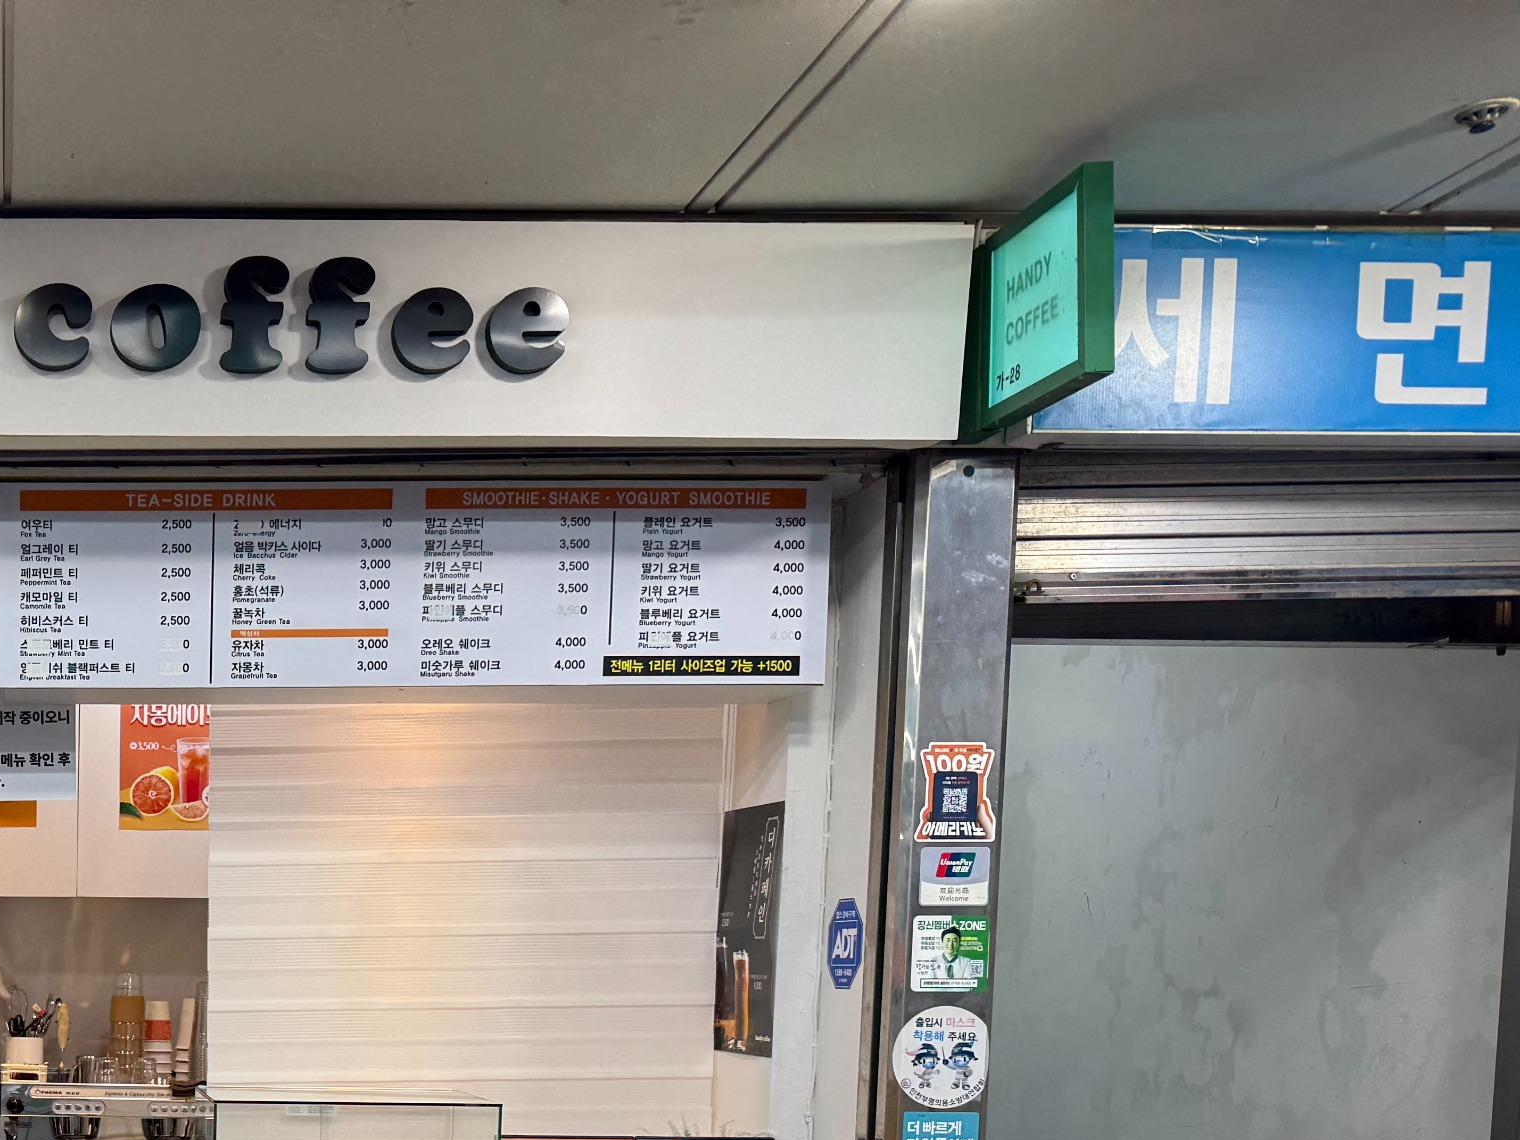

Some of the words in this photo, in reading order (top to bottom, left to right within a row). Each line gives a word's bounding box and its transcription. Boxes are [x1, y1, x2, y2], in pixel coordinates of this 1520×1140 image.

[1006, 252, 1052, 301] HANDY
[14, 255, 570, 376] coffee
[1005, 295, 1060, 345] COFFEE
[996, 363, 1021, 392] 가-28
[126, 494, 213, 507] TEA-SIDE
[222, 494, 276, 507] DRINK
[617, 492, 680, 506] YOGURT
[689, 492, 771, 506] SMOOTHIE
[21, 520, 53, 531] 여우티
[162, 520, 192, 530] 2,500
[425, 517, 447, 529] 망고
[452, 517, 484, 529] 스무디
[560, 517, 590, 528] 3,500
[643, 517, 676, 528] 플레인
[681, 517, 713, 528] 요거트
[775, 517, 806, 528] 3,500
[234, 541, 254, 552] 얼음
[258, 541, 288, 552] 박카스
[291, 541, 321, 552] 사이다
[361, 539, 392, 549] 3,000
[234, 564, 266, 574] 체리콕
[233, 585, 284, 596] 홍초(석류)
[232, 640, 264, 650] 유자차
[358, 639, 388, 649] 3,000
[422, 637, 454, 649] 오레오
[459, 637, 491, 649] 쉐이크
[555, 637, 586, 648] 4,000
[610, 659, 644, 672] 전메뉴
[648, 659, 676, 672] 1리터
[680, 659, 725, 673] 사이즈업
[730, 659, 753, 672] 가능
[757, 660, 792, 672] +1500
[19, 710, 70, 725] 중이오니
[138, 742, 159, 751] 3,500
[1, 753, 26, 768] 메뉴
[29, 753, 54, 767] 확인
[58, 753, 71, 766] 후
[926, 754, 989, 774] 100원
[922, 822, 986, 836] 아메리카노
[940, 858, 972, 868] UnionPay
[832, 928, 858, 959] ADT
[915, 1017, 942, 1027] 출입시
[946, 1017, 976, 1027] 마스크
[913, 1031, 944, 1041] 착용해
[948, 1031, 978, 1042] 주세요
[907, 1121, 920, 1135] 더
[923, 1121, 962, 1135] 빠르게
